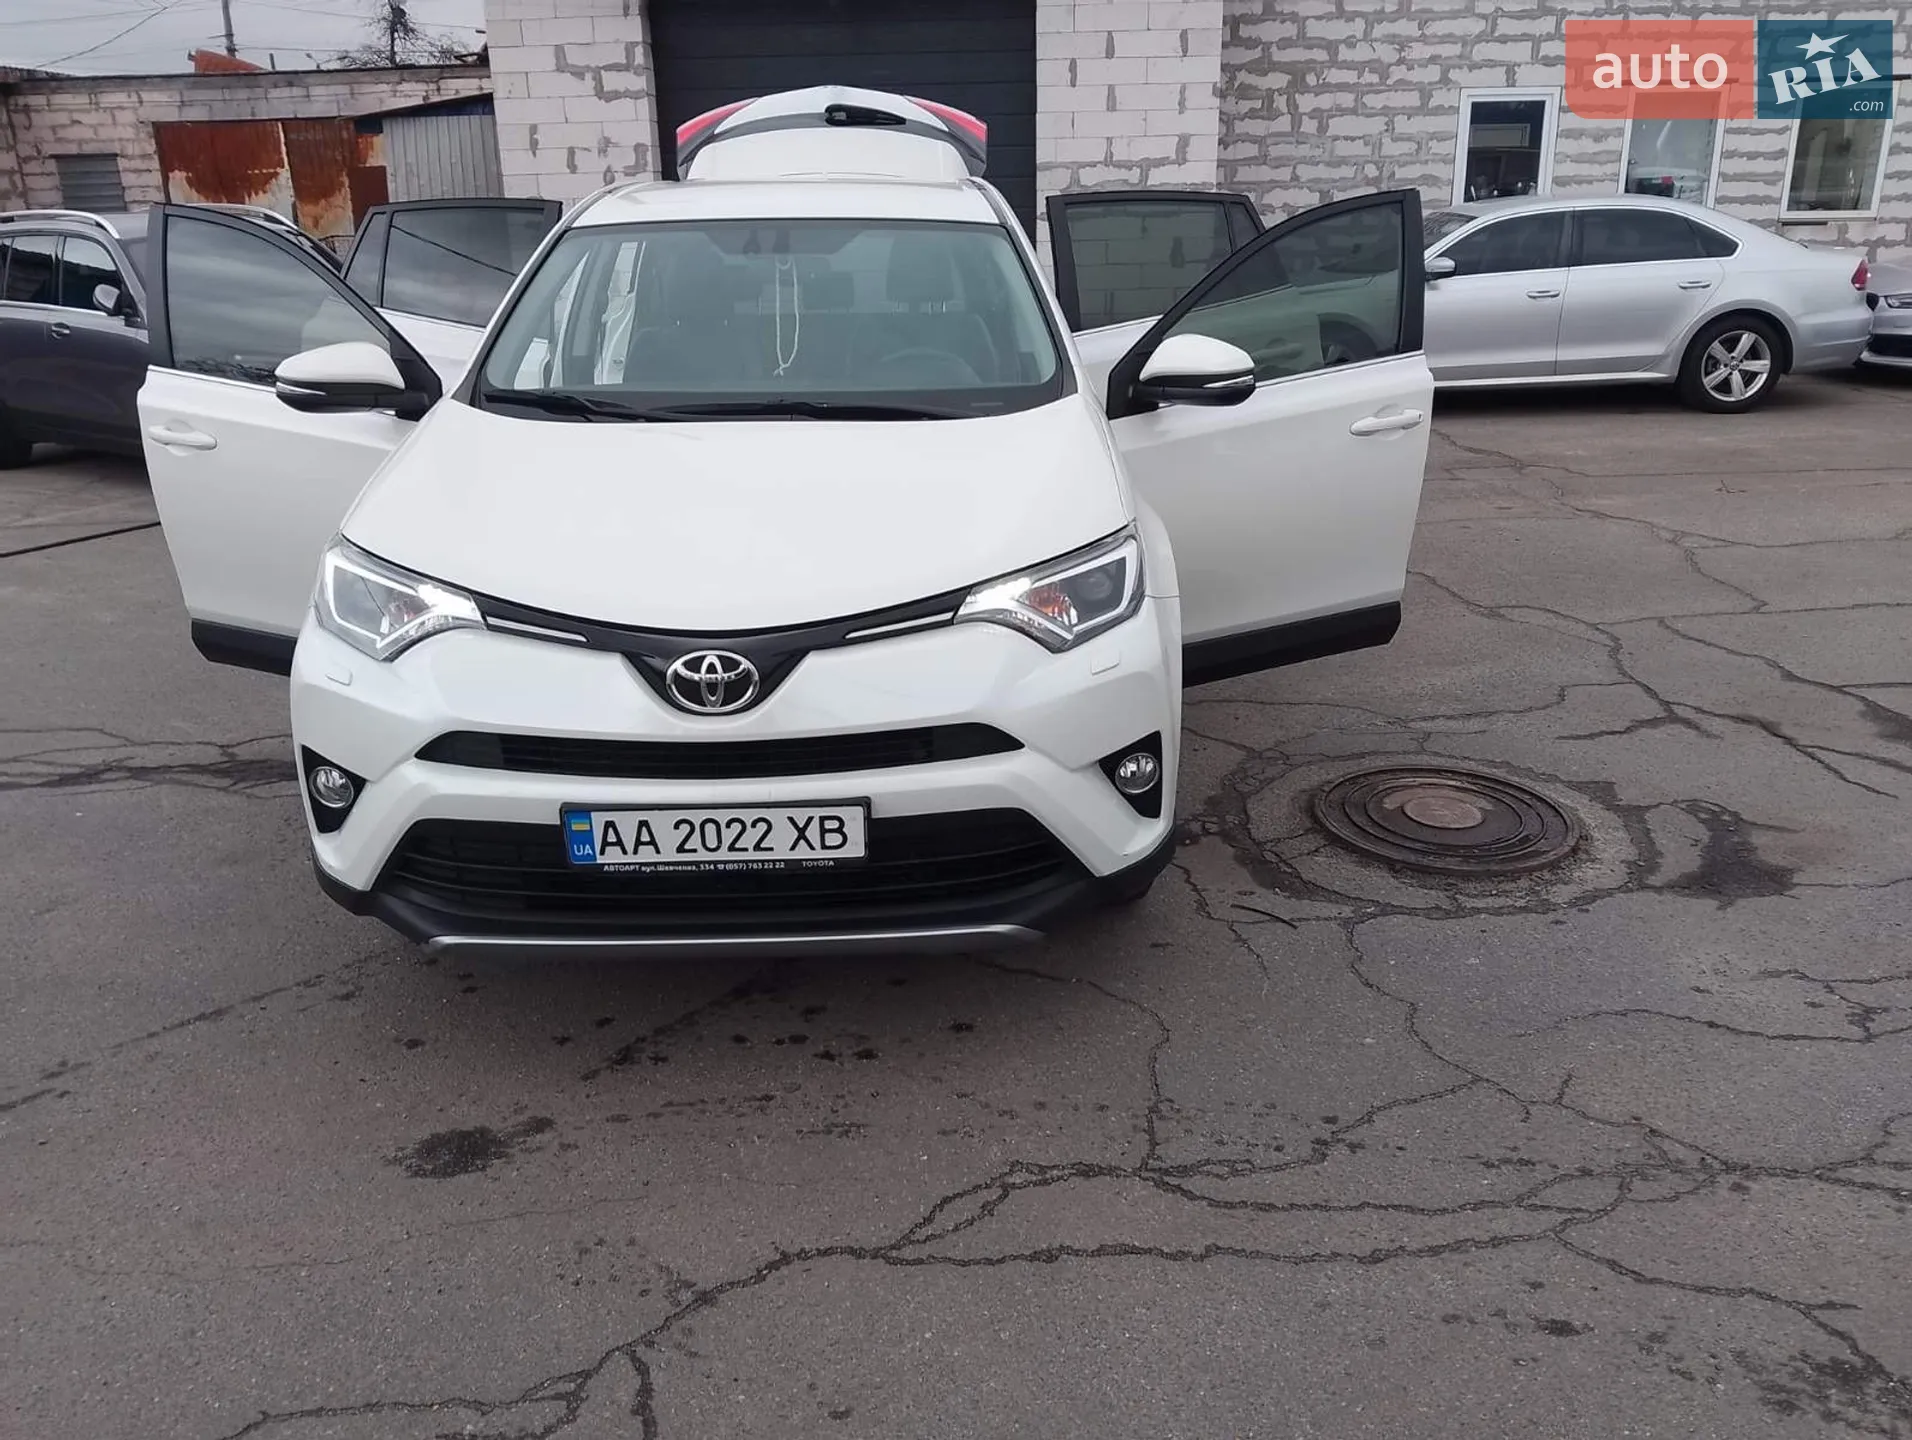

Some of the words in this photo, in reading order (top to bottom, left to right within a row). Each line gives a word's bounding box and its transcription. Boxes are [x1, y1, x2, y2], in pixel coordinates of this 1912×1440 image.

[599, 819, 661, 857] AA
[672, 817, 774, 855] 2022
[786, 815, 849, 852] XB
[573, 843, 594, 857] UA
[725, 862, 747, 871] (057)
[764, 861, 774, 869] 22
[775, 861, 786, 869] 22
[802, 859, 835, 868] TOYOTA
